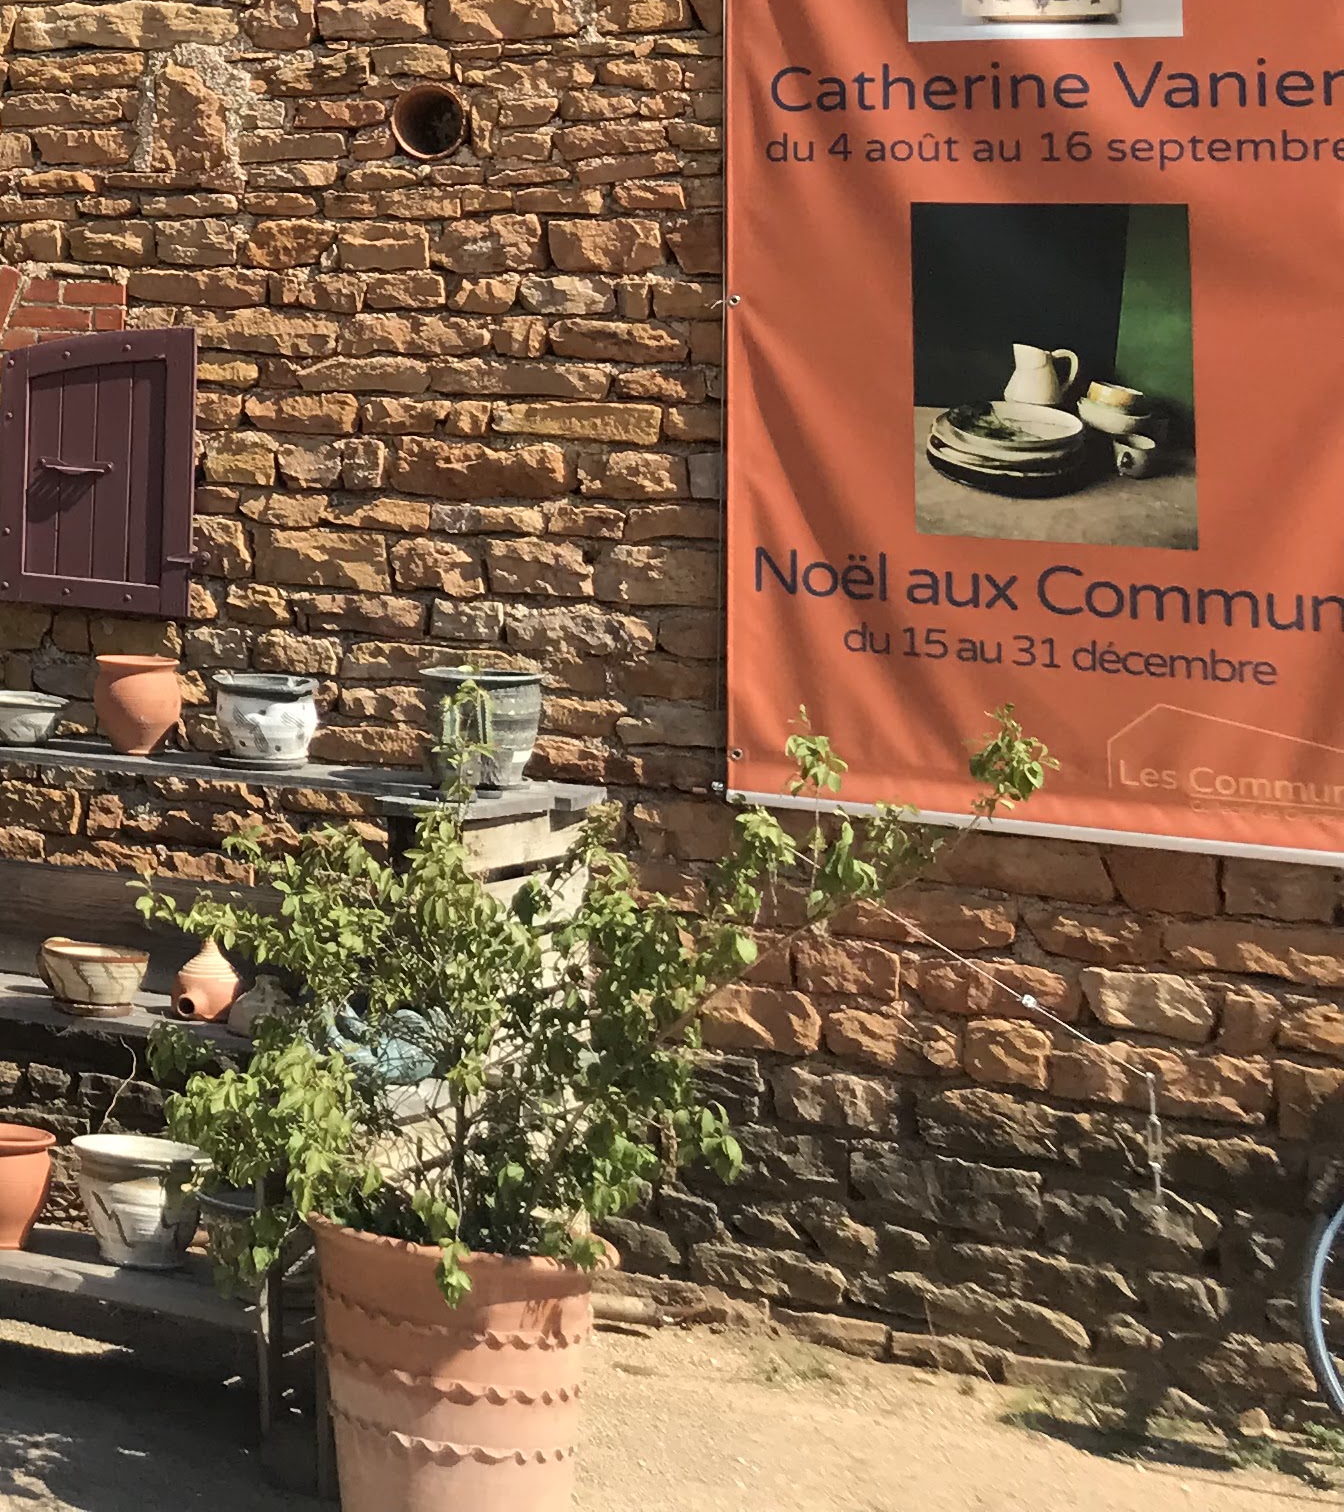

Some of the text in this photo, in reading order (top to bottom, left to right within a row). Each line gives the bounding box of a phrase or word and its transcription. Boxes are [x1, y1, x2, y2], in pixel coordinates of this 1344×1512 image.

[769, 57, 1344, 113] Catherine Vanier
[765, 133, 815, 163] du
[826, 133, 853, 163] 4
[865, 132, 959, 163] août
[972, 138, 1022, 163] au
[1039, 131, 1093, 163] 16
[753, 545, 1344, 634] Noël aux Commun
[842, 621, 1279, 687] du 15 au 31 décembre
[1119, 759, 1178, 790] Les
